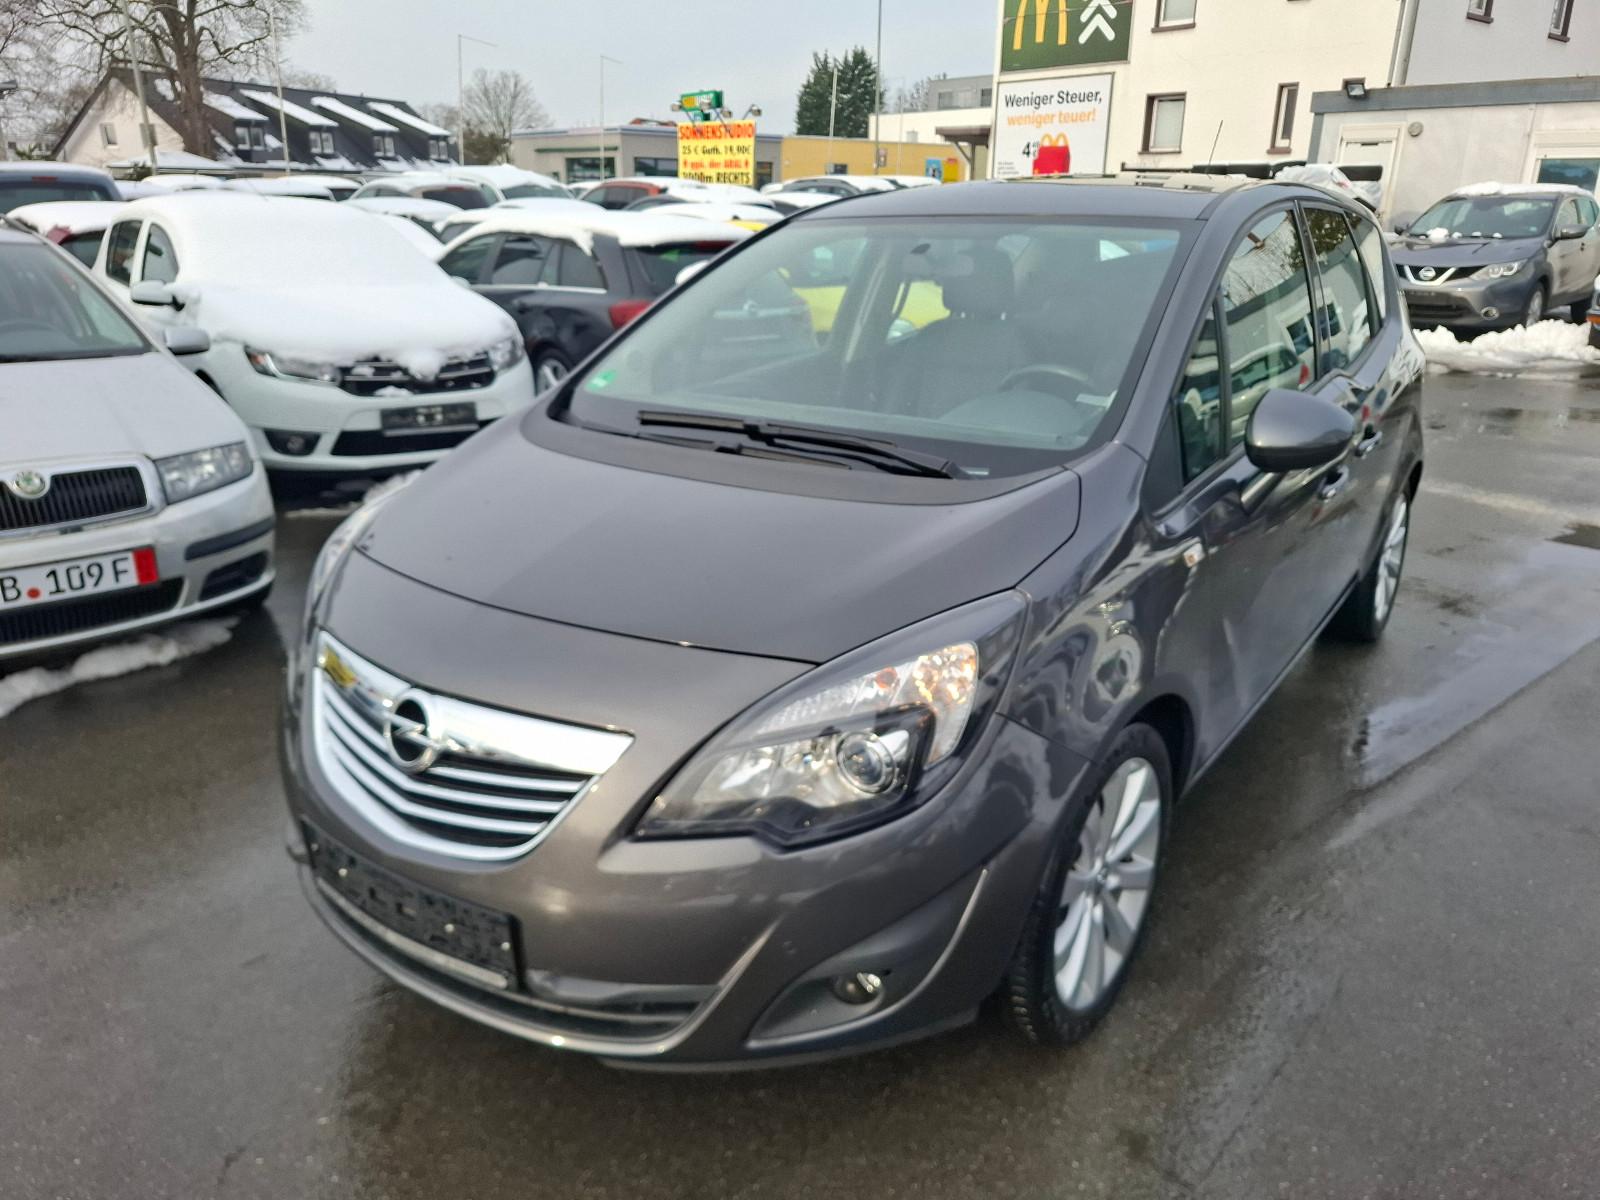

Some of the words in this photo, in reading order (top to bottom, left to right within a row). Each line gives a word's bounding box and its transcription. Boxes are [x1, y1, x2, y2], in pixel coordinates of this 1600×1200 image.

[1004, 91, 1054, 110] Weniger
[1056, 90, 1102, 105] Steuer,
[1007, 111, 1055, 128] weniger
[1058, 108, 1096, 124] teuer!
[45, 562, 104, 594] 109
[112, 557, 129, 583] F
